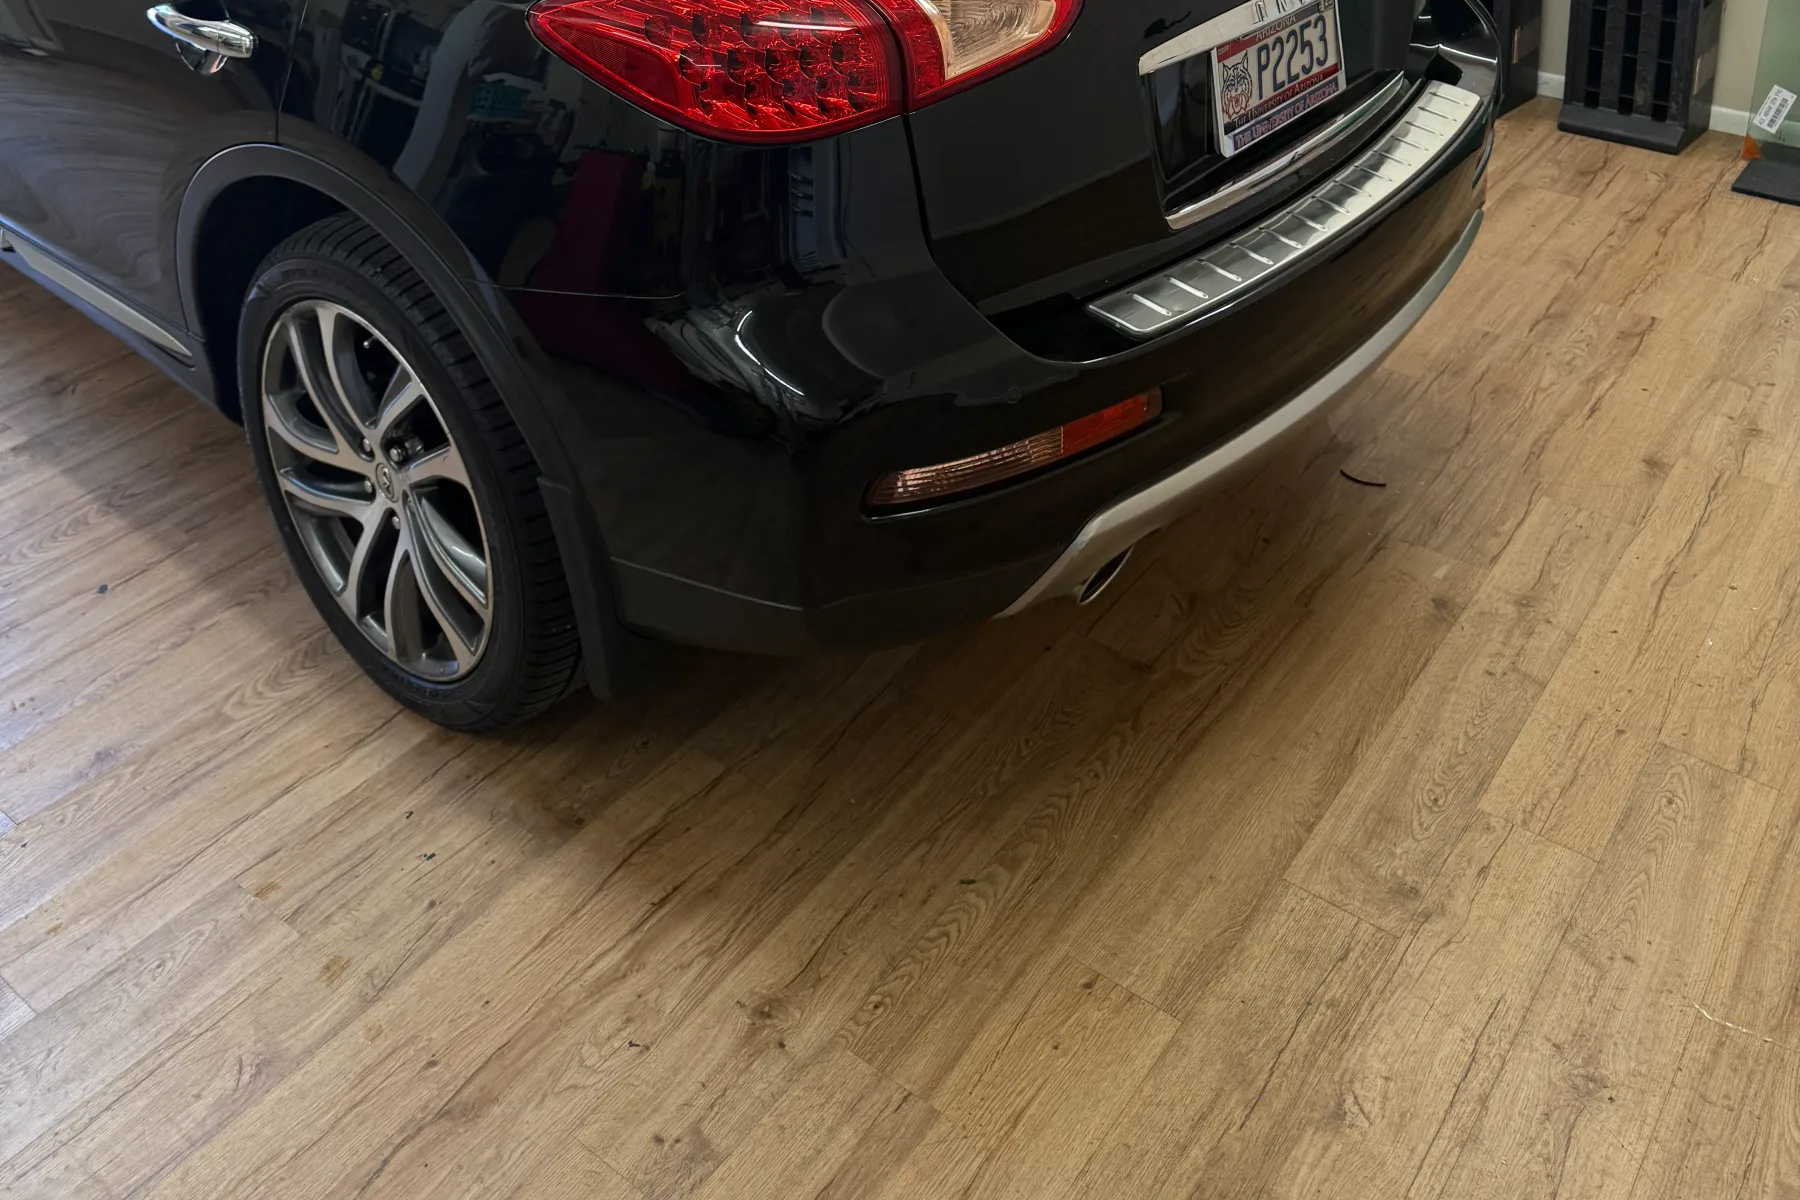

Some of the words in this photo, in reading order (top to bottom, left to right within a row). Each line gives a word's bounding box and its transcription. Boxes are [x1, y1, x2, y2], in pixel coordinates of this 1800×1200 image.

[1255, 14, 1297, 42] ARIZONA
[1257, 14, 1329, 100] P2253
[1252, 107, 1294, 138] UNIVERSITY
[1304, 82, 1338, 109] ARIZONA
